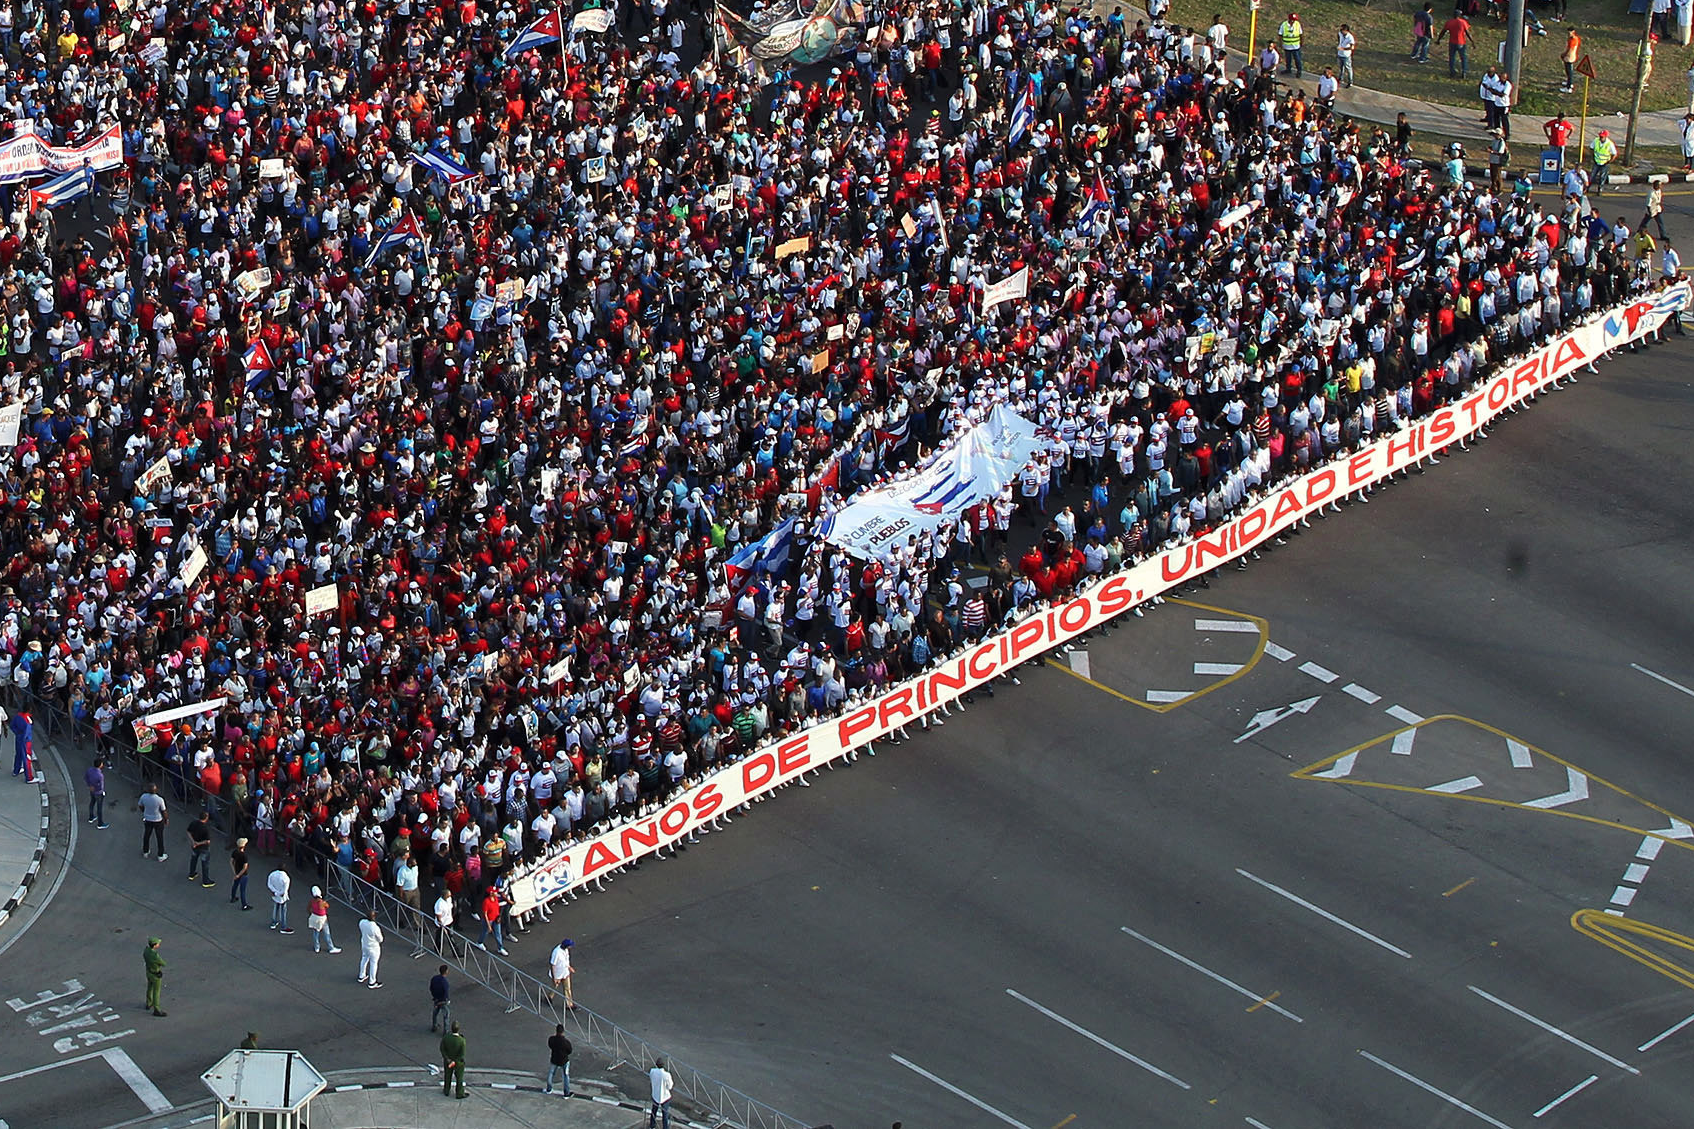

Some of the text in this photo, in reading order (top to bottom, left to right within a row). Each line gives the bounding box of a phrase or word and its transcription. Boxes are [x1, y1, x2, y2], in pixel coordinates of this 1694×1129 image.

[851, 515, 886, 540] CUMBRE
[869, 517, 910, 545] PUEBLOS
[582, 783, 724, 876] AÑOS
[742, 734, 811, 794] DE
[838, 576, 1144, 748] PRINCIPIOS,
[1160, 470, 1335, 582] UNIDAD
[1349, 448, 1377, 486] E
[1386, 337, 1586, 468] HISTORIA
